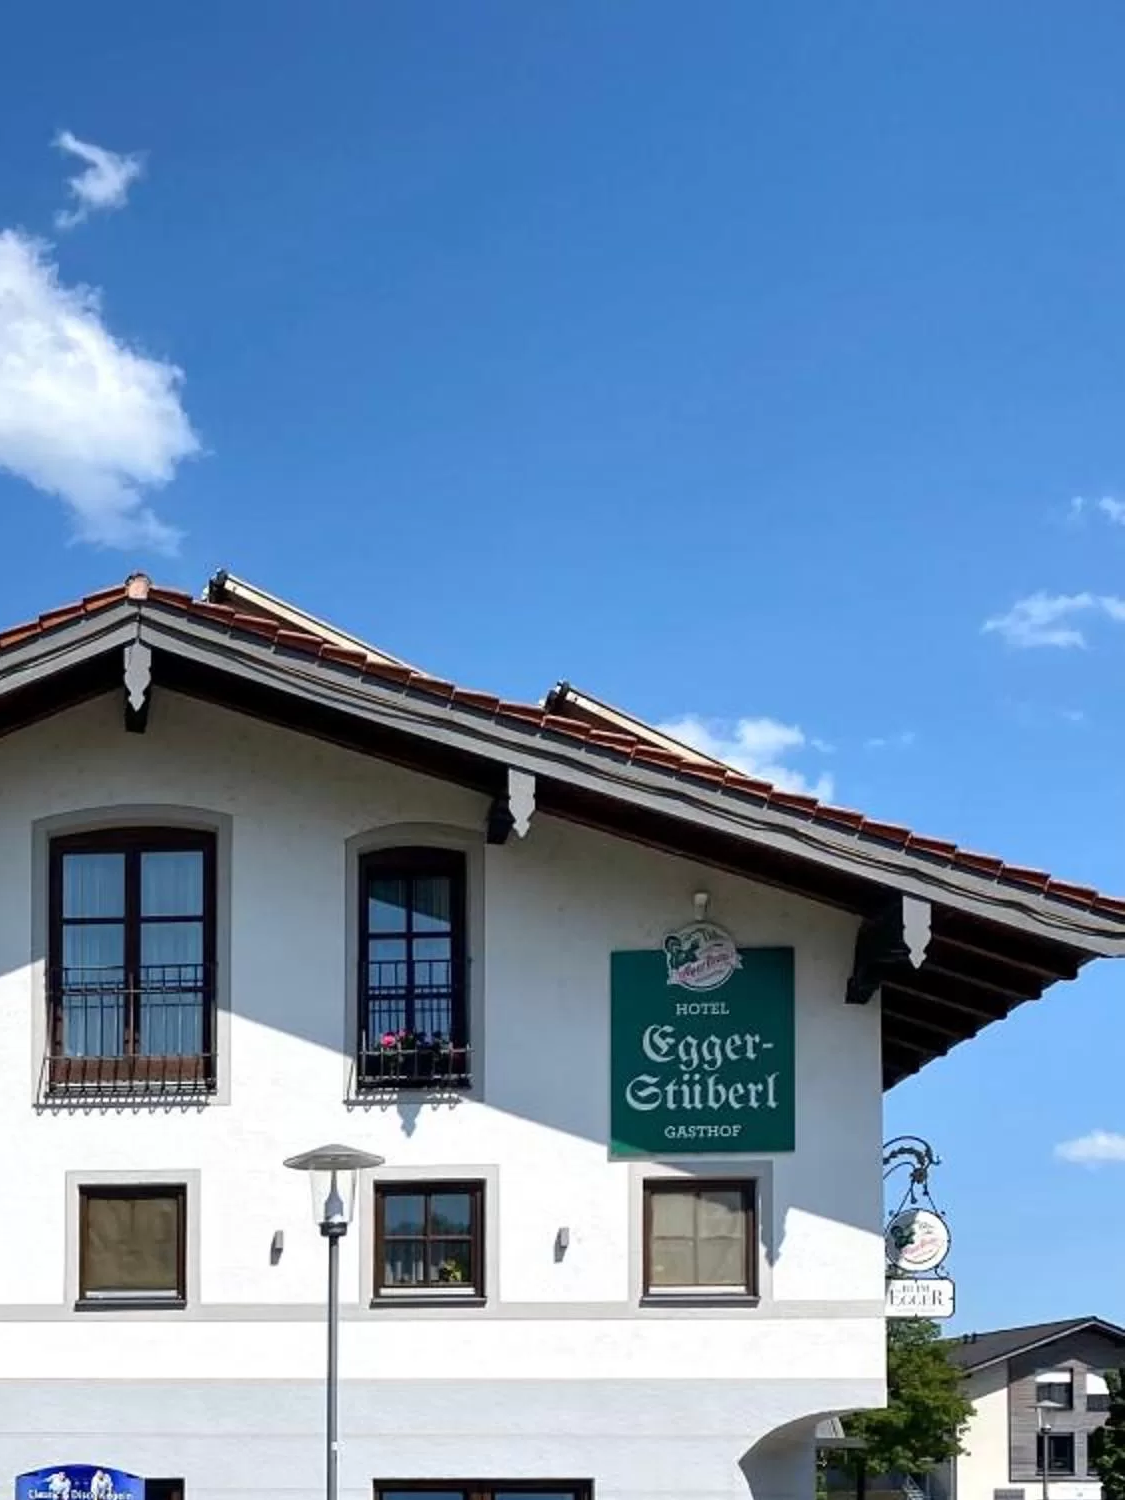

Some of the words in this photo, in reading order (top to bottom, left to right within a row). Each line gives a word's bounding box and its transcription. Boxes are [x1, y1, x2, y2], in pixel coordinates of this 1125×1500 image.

[675, 1002, 730, 1016] HOTEL
[642, 1024, 774, 1071] Egger-
[625, 1072, 780, 1112] Stüberl
[663, 1124, 743, 1139] GASTHOF
